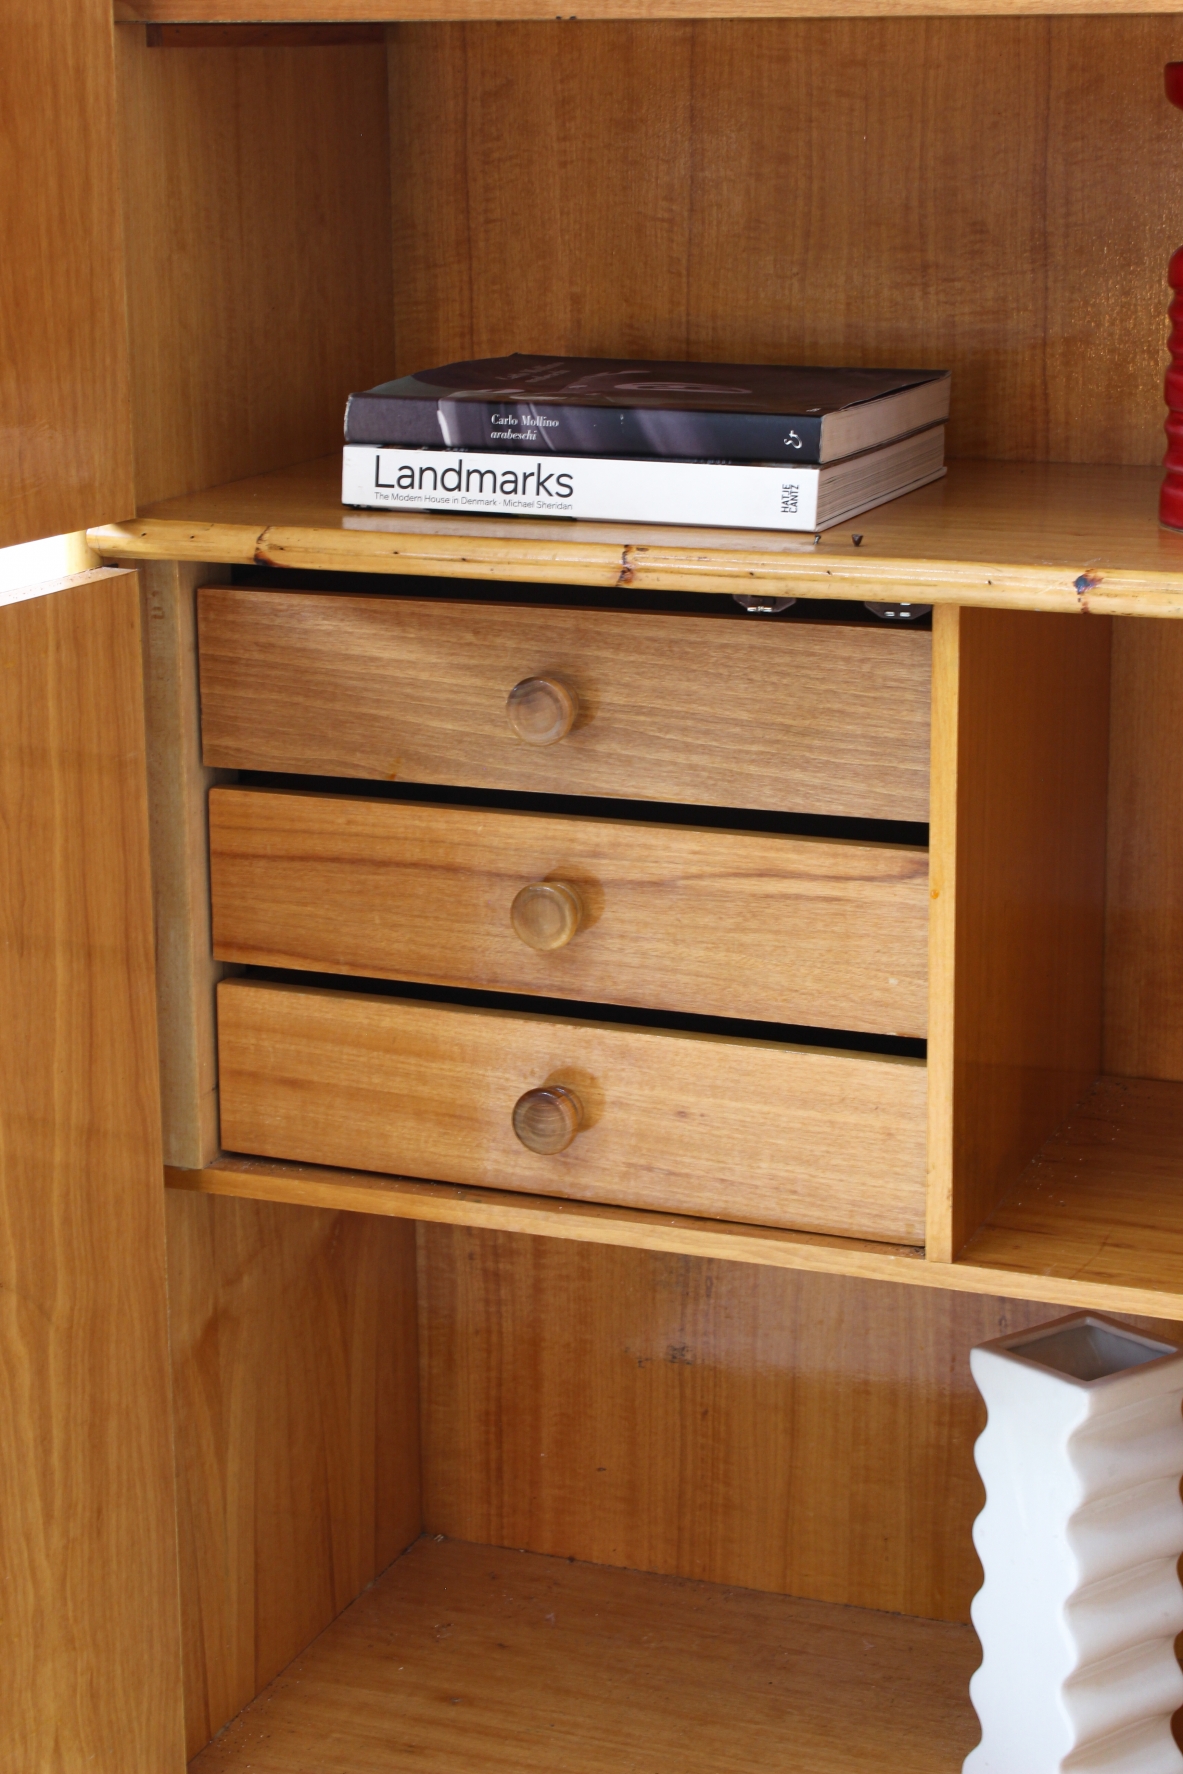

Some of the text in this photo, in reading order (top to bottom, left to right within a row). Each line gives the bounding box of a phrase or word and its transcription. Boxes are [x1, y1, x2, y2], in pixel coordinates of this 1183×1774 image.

[491, 413, 560, 427] Carlo Mollino
[490, 428, 537, 440] arabeschi
[375, 455, 574, 498] Landmarks
[374, 491, 573, 511] The Modern House in Denmark Michael Sheridan
[780, 484, 792, 513] HATJE
[789, 484, 799, 513] CANTZ
